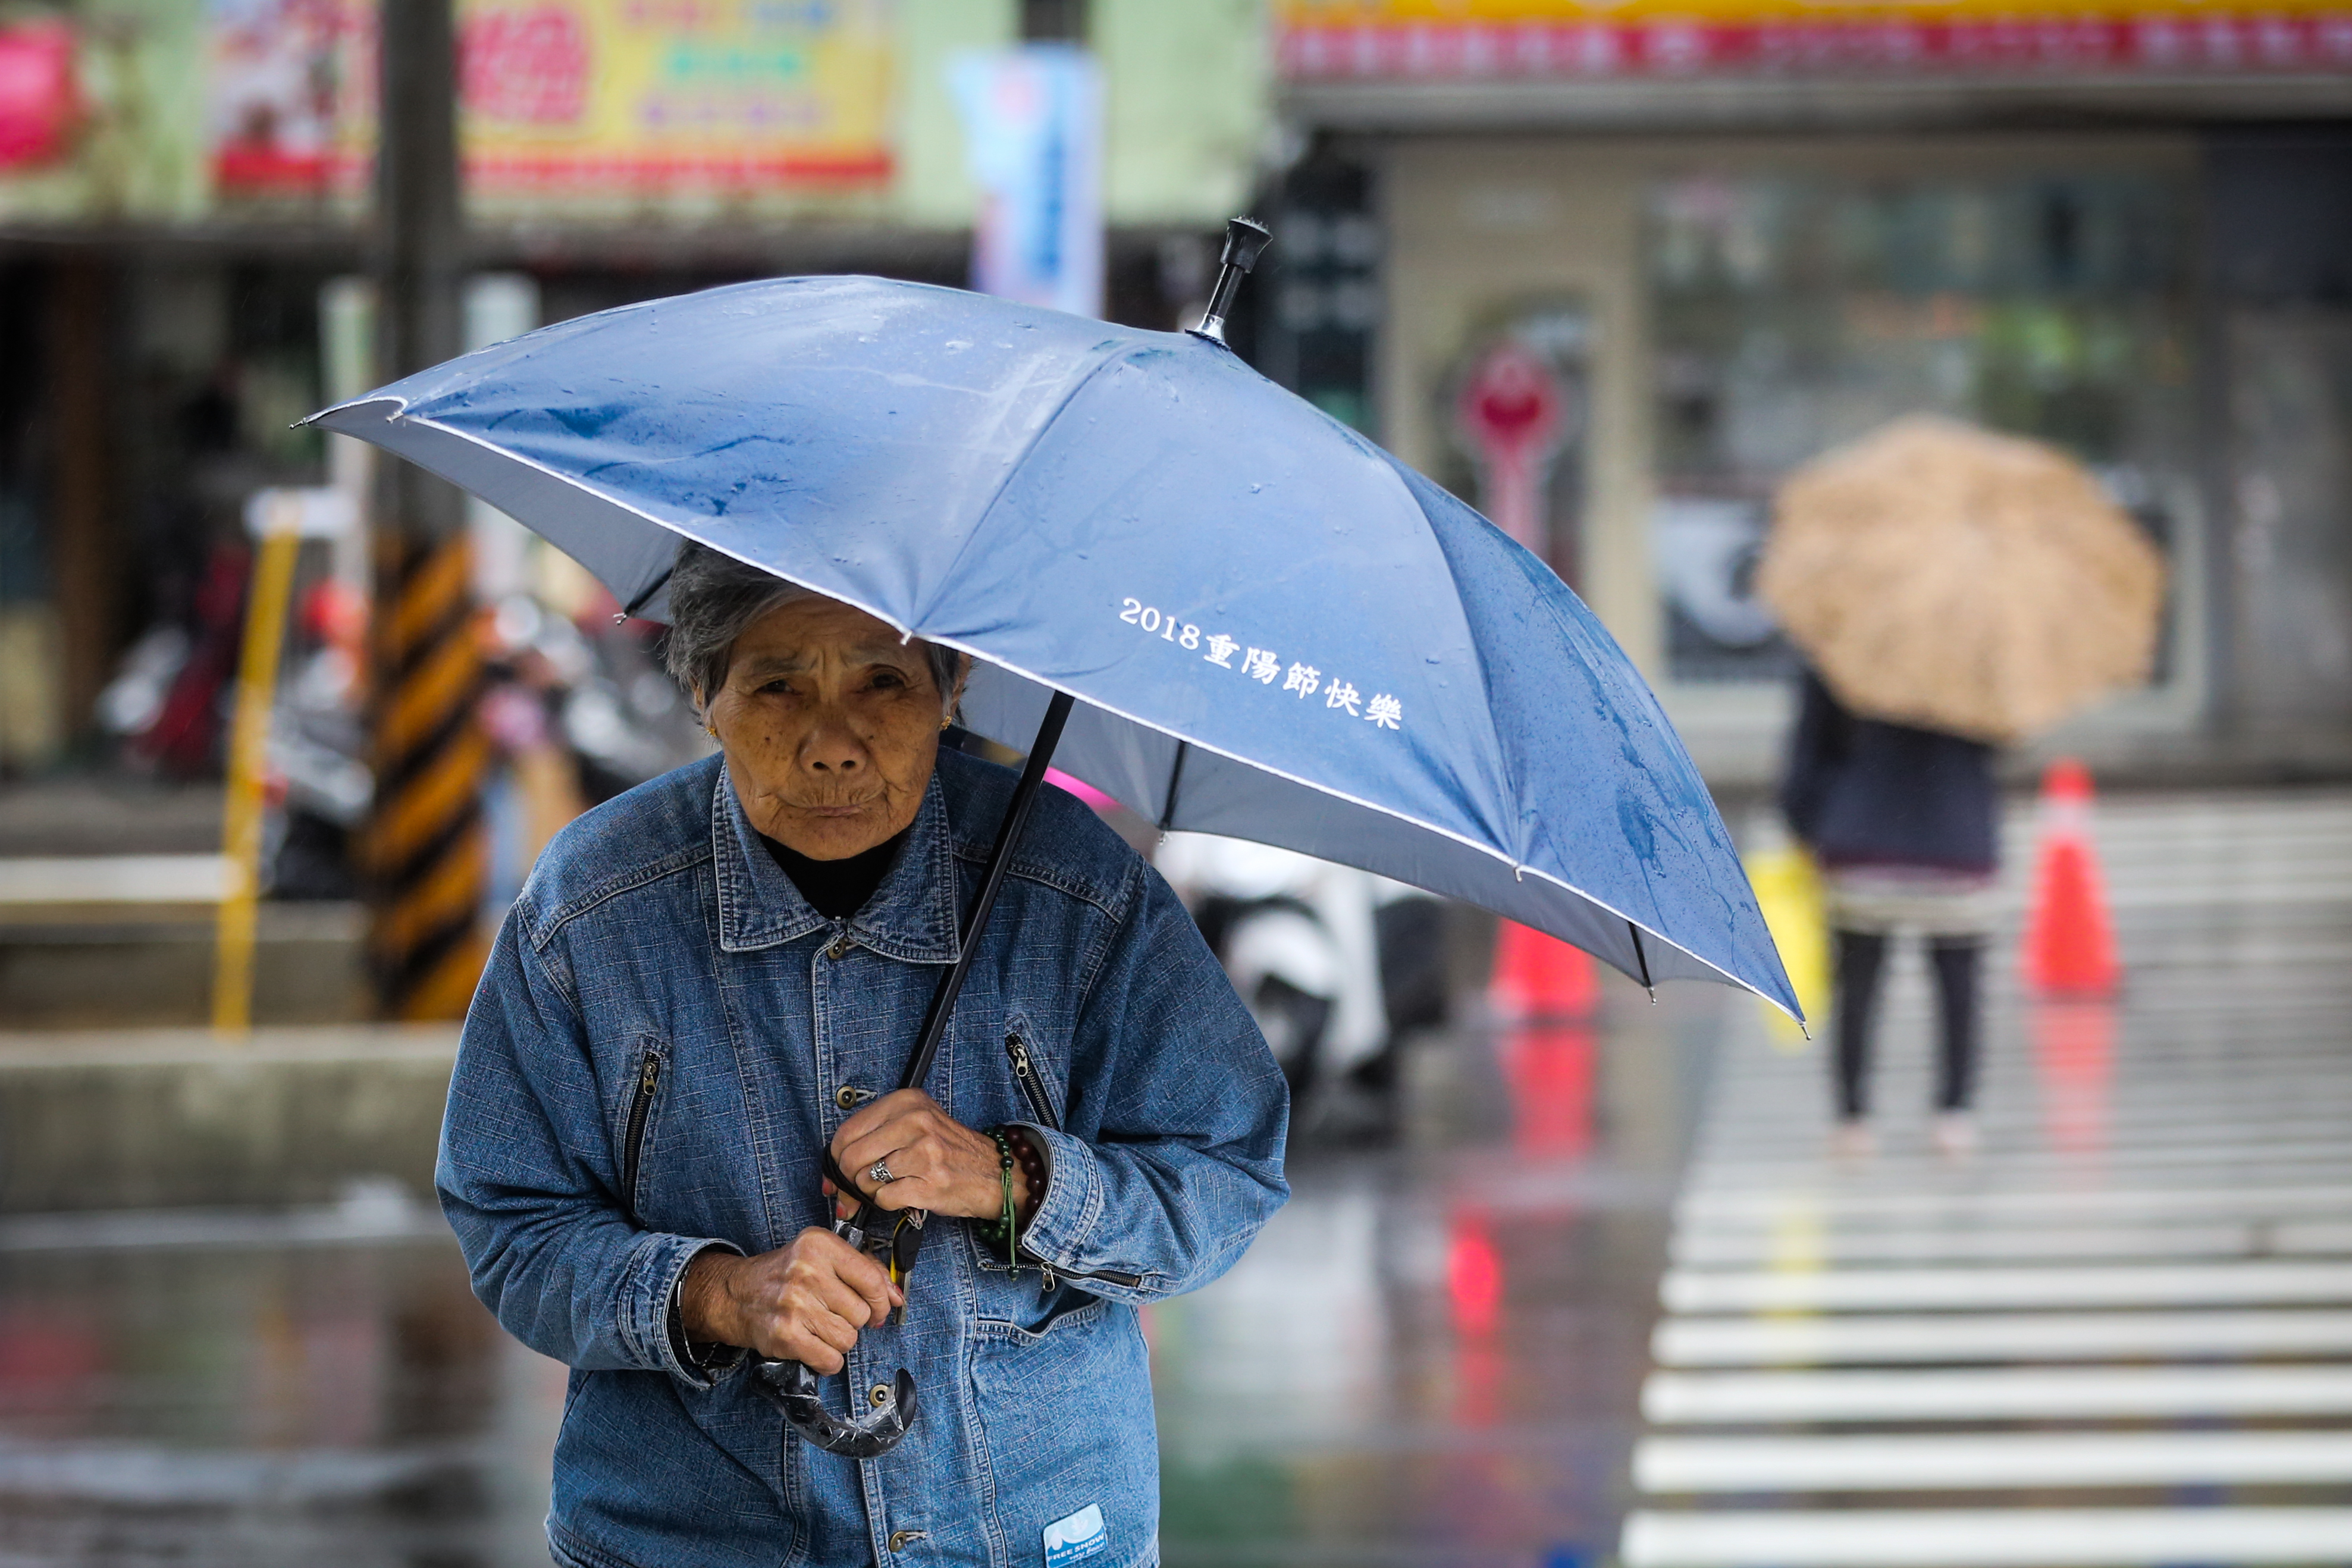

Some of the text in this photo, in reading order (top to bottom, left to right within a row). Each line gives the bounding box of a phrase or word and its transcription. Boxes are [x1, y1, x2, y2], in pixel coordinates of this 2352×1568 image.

[1119, 597, 1402, 730] 2018重陽節快樂
[1047, 1533, 1105, 1561] FREE SNOW
